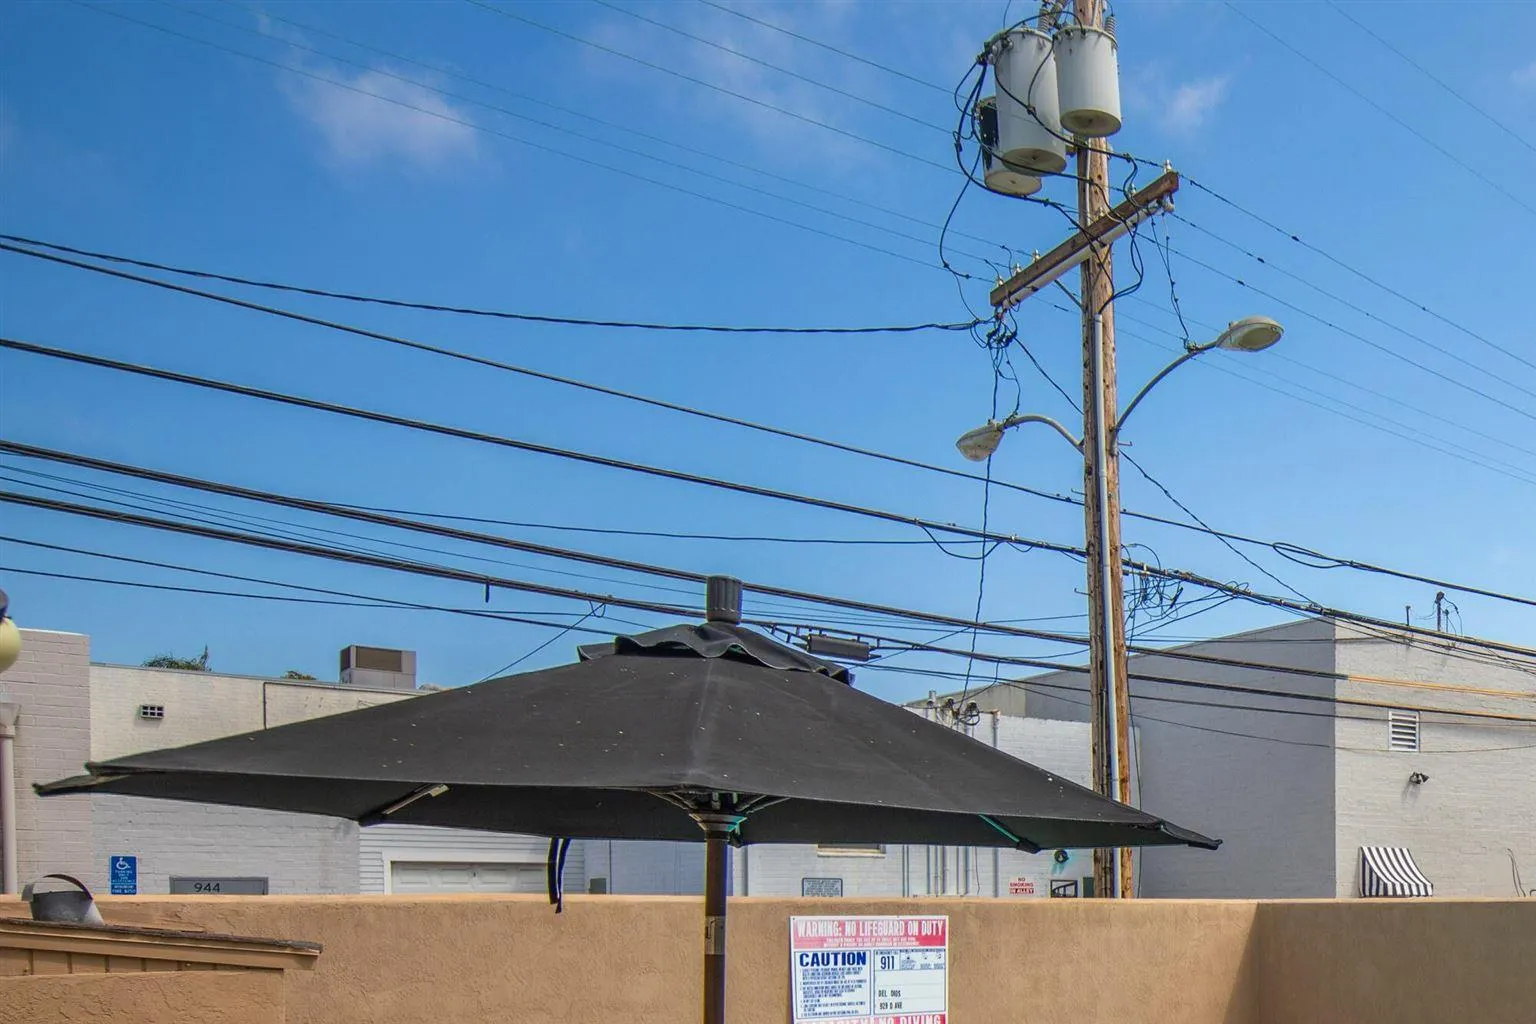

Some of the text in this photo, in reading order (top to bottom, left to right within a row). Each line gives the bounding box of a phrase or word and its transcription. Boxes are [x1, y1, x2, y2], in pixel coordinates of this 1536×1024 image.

[193, 882, 221, 893] 944
[797, 919, 944, 937] WARNING: NO LIFEGUARD ON DUTY
[799, 951, 867, 967] CAUTION
[880, 956, 895, 970] 911
